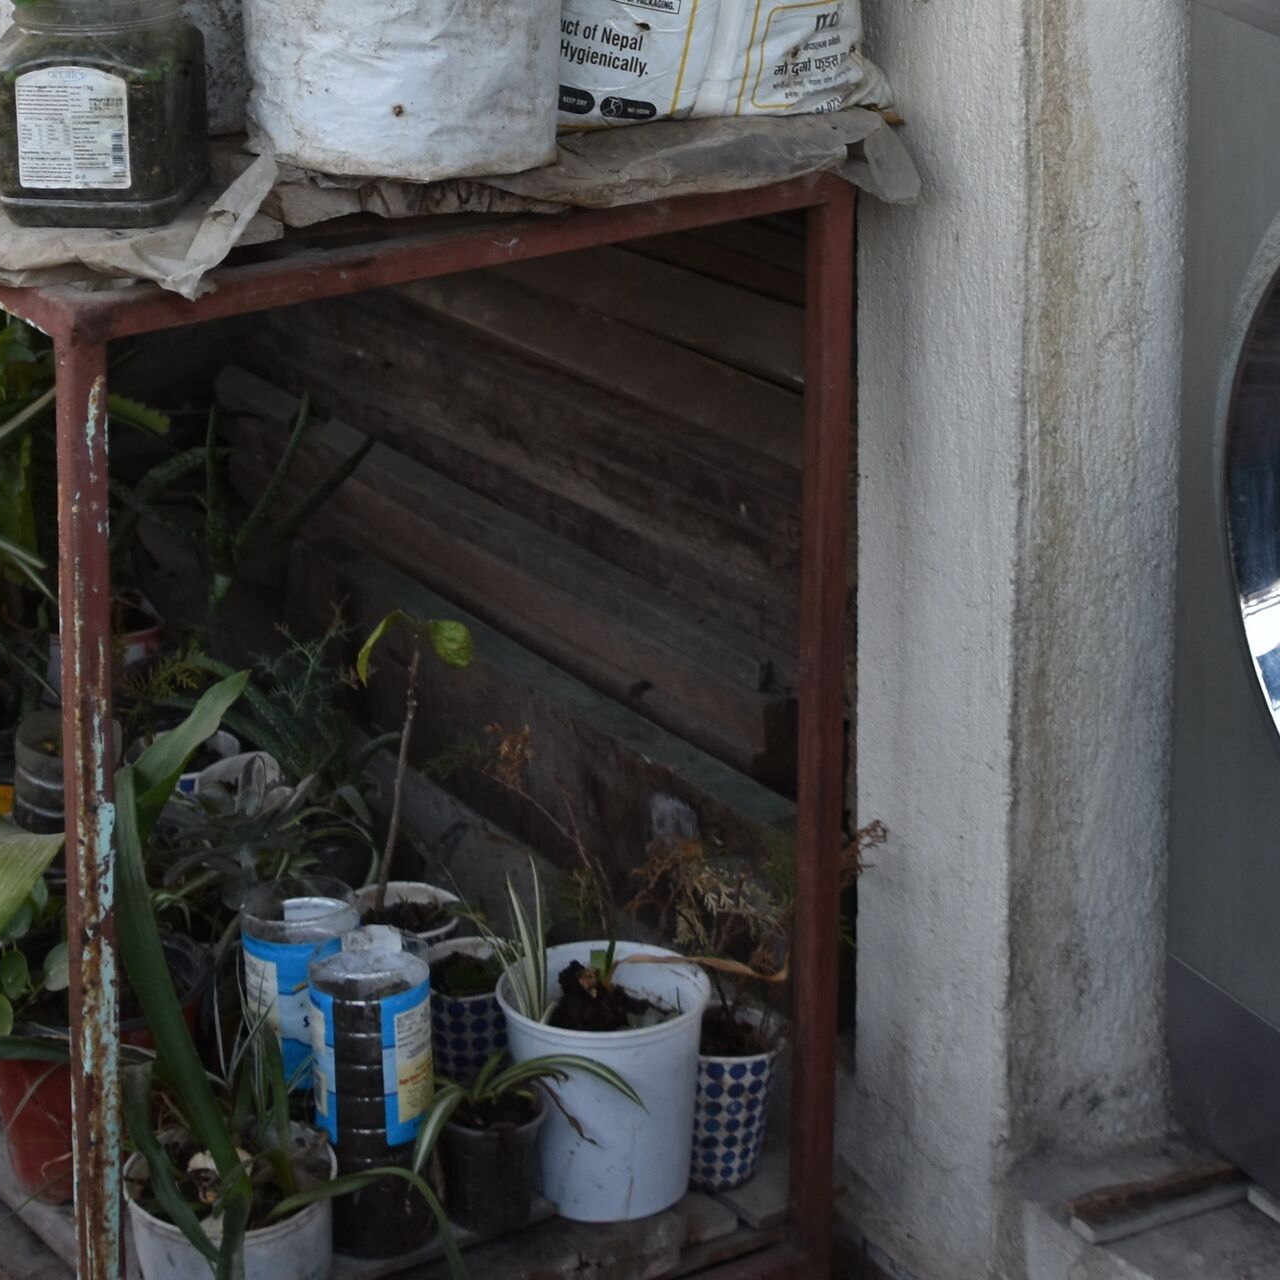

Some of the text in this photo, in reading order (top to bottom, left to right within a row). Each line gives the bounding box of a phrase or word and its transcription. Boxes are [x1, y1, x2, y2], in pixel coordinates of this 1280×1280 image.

[582, 24, 599, 40] of
[600, 26, 644, 52] Nepal
[560, 39, 649, 78] Hygienically.
